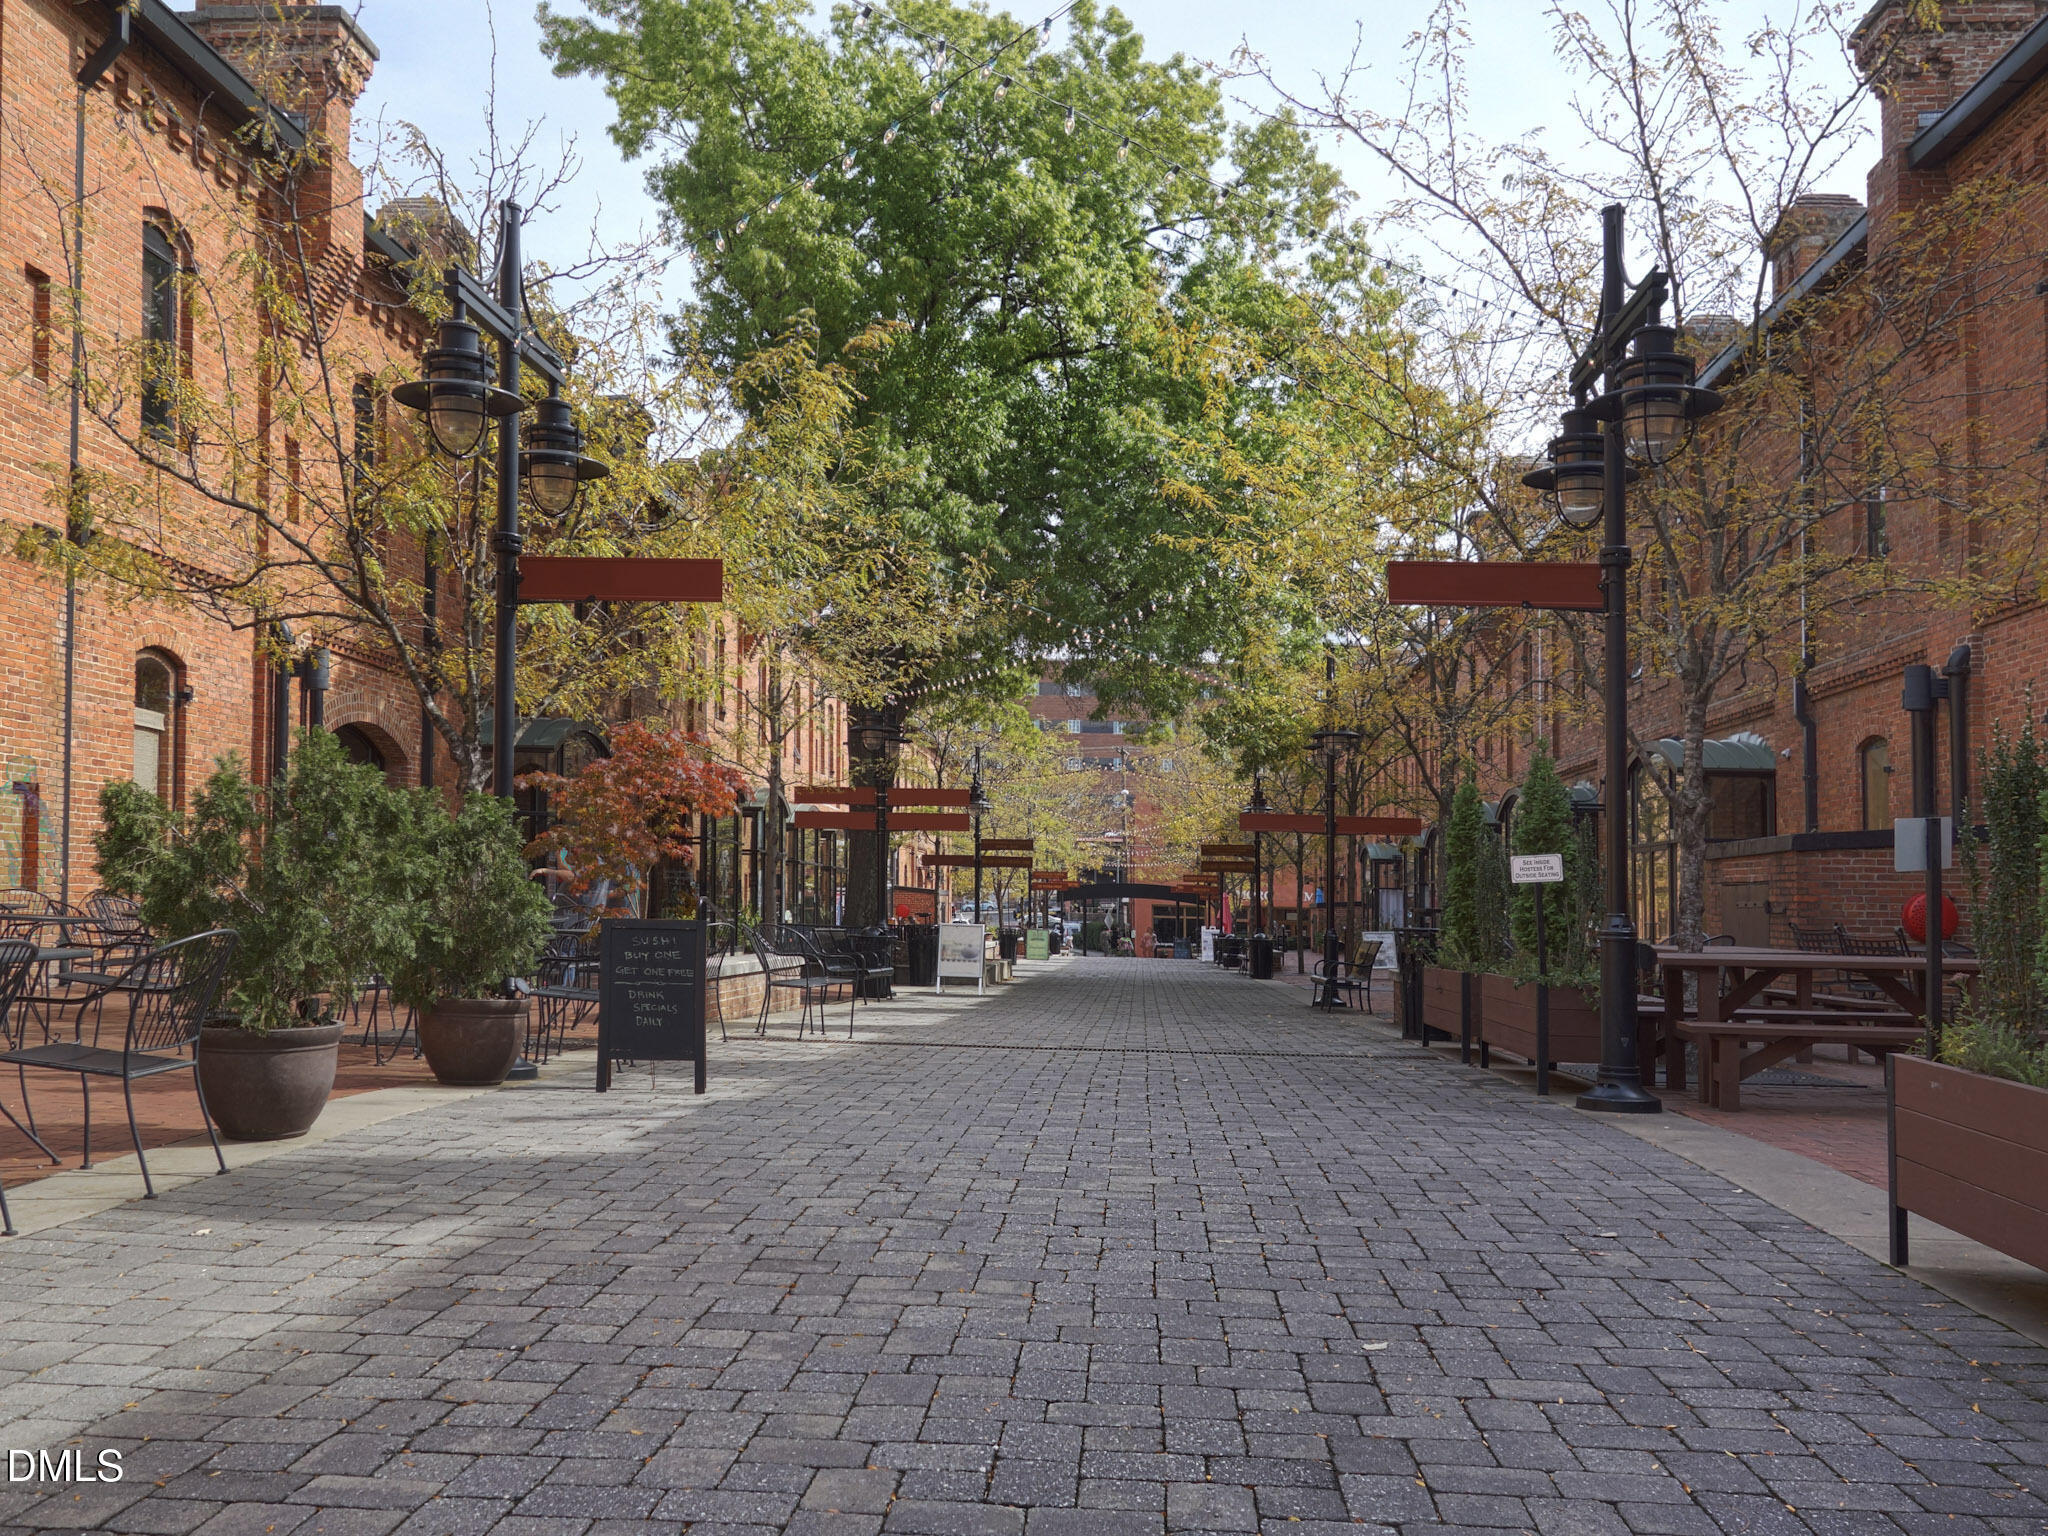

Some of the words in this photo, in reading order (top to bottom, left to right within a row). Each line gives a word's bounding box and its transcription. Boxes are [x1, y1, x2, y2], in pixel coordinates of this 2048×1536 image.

[632, 936, 677, 947] SUSHI
[624, 951, 649, 960] BUY
[654, 950, 682, 960] ONE
[615, 966, 640, 976] GET
[643, 967, 666, 976] ONE
[667, 968, 695, 977] FREE
[628, 989, 664, 1000] DRINK
[633, 1003, 678, 1014] SPECIALS
[636, 1015, 663, 1027] DAILY
